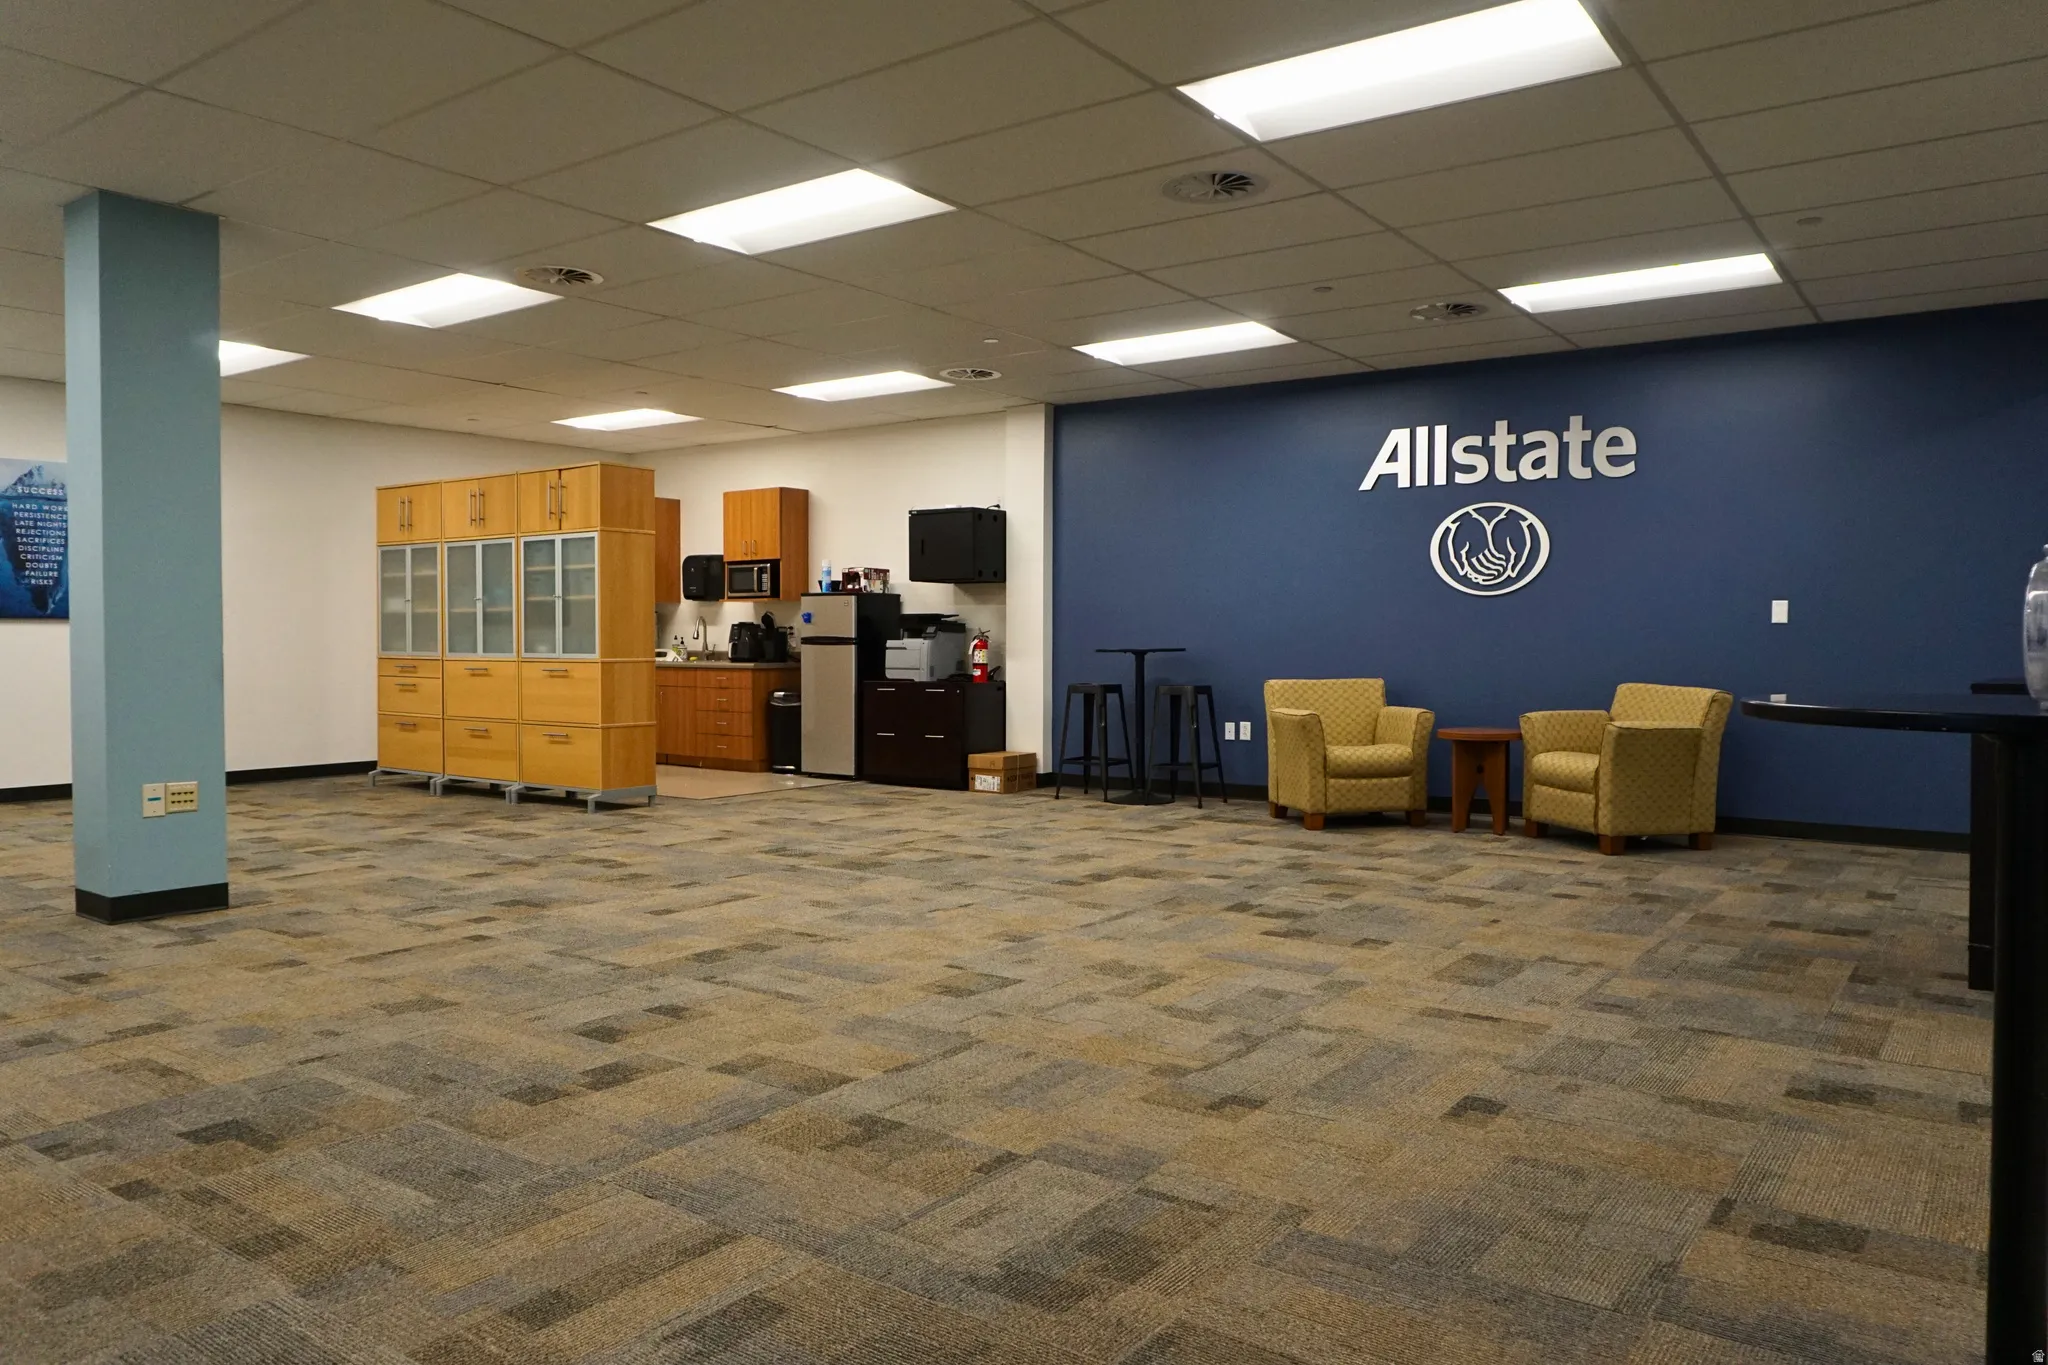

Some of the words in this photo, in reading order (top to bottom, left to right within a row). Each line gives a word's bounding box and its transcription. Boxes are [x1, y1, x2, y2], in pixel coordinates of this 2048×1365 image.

[1358, 415, 1637, 491] Allstate
[17, 486, 64, 496] SUCCESS
[13, 511, 67, 520] PERSISTENCE
[15, 528, 66, 536] REJECTIONS
[16, 536, 65, 545] SACRIFICES
[18, 545, 64, 553] DISCIPLINE
[20, 553, 63, 561] CRITICISM
